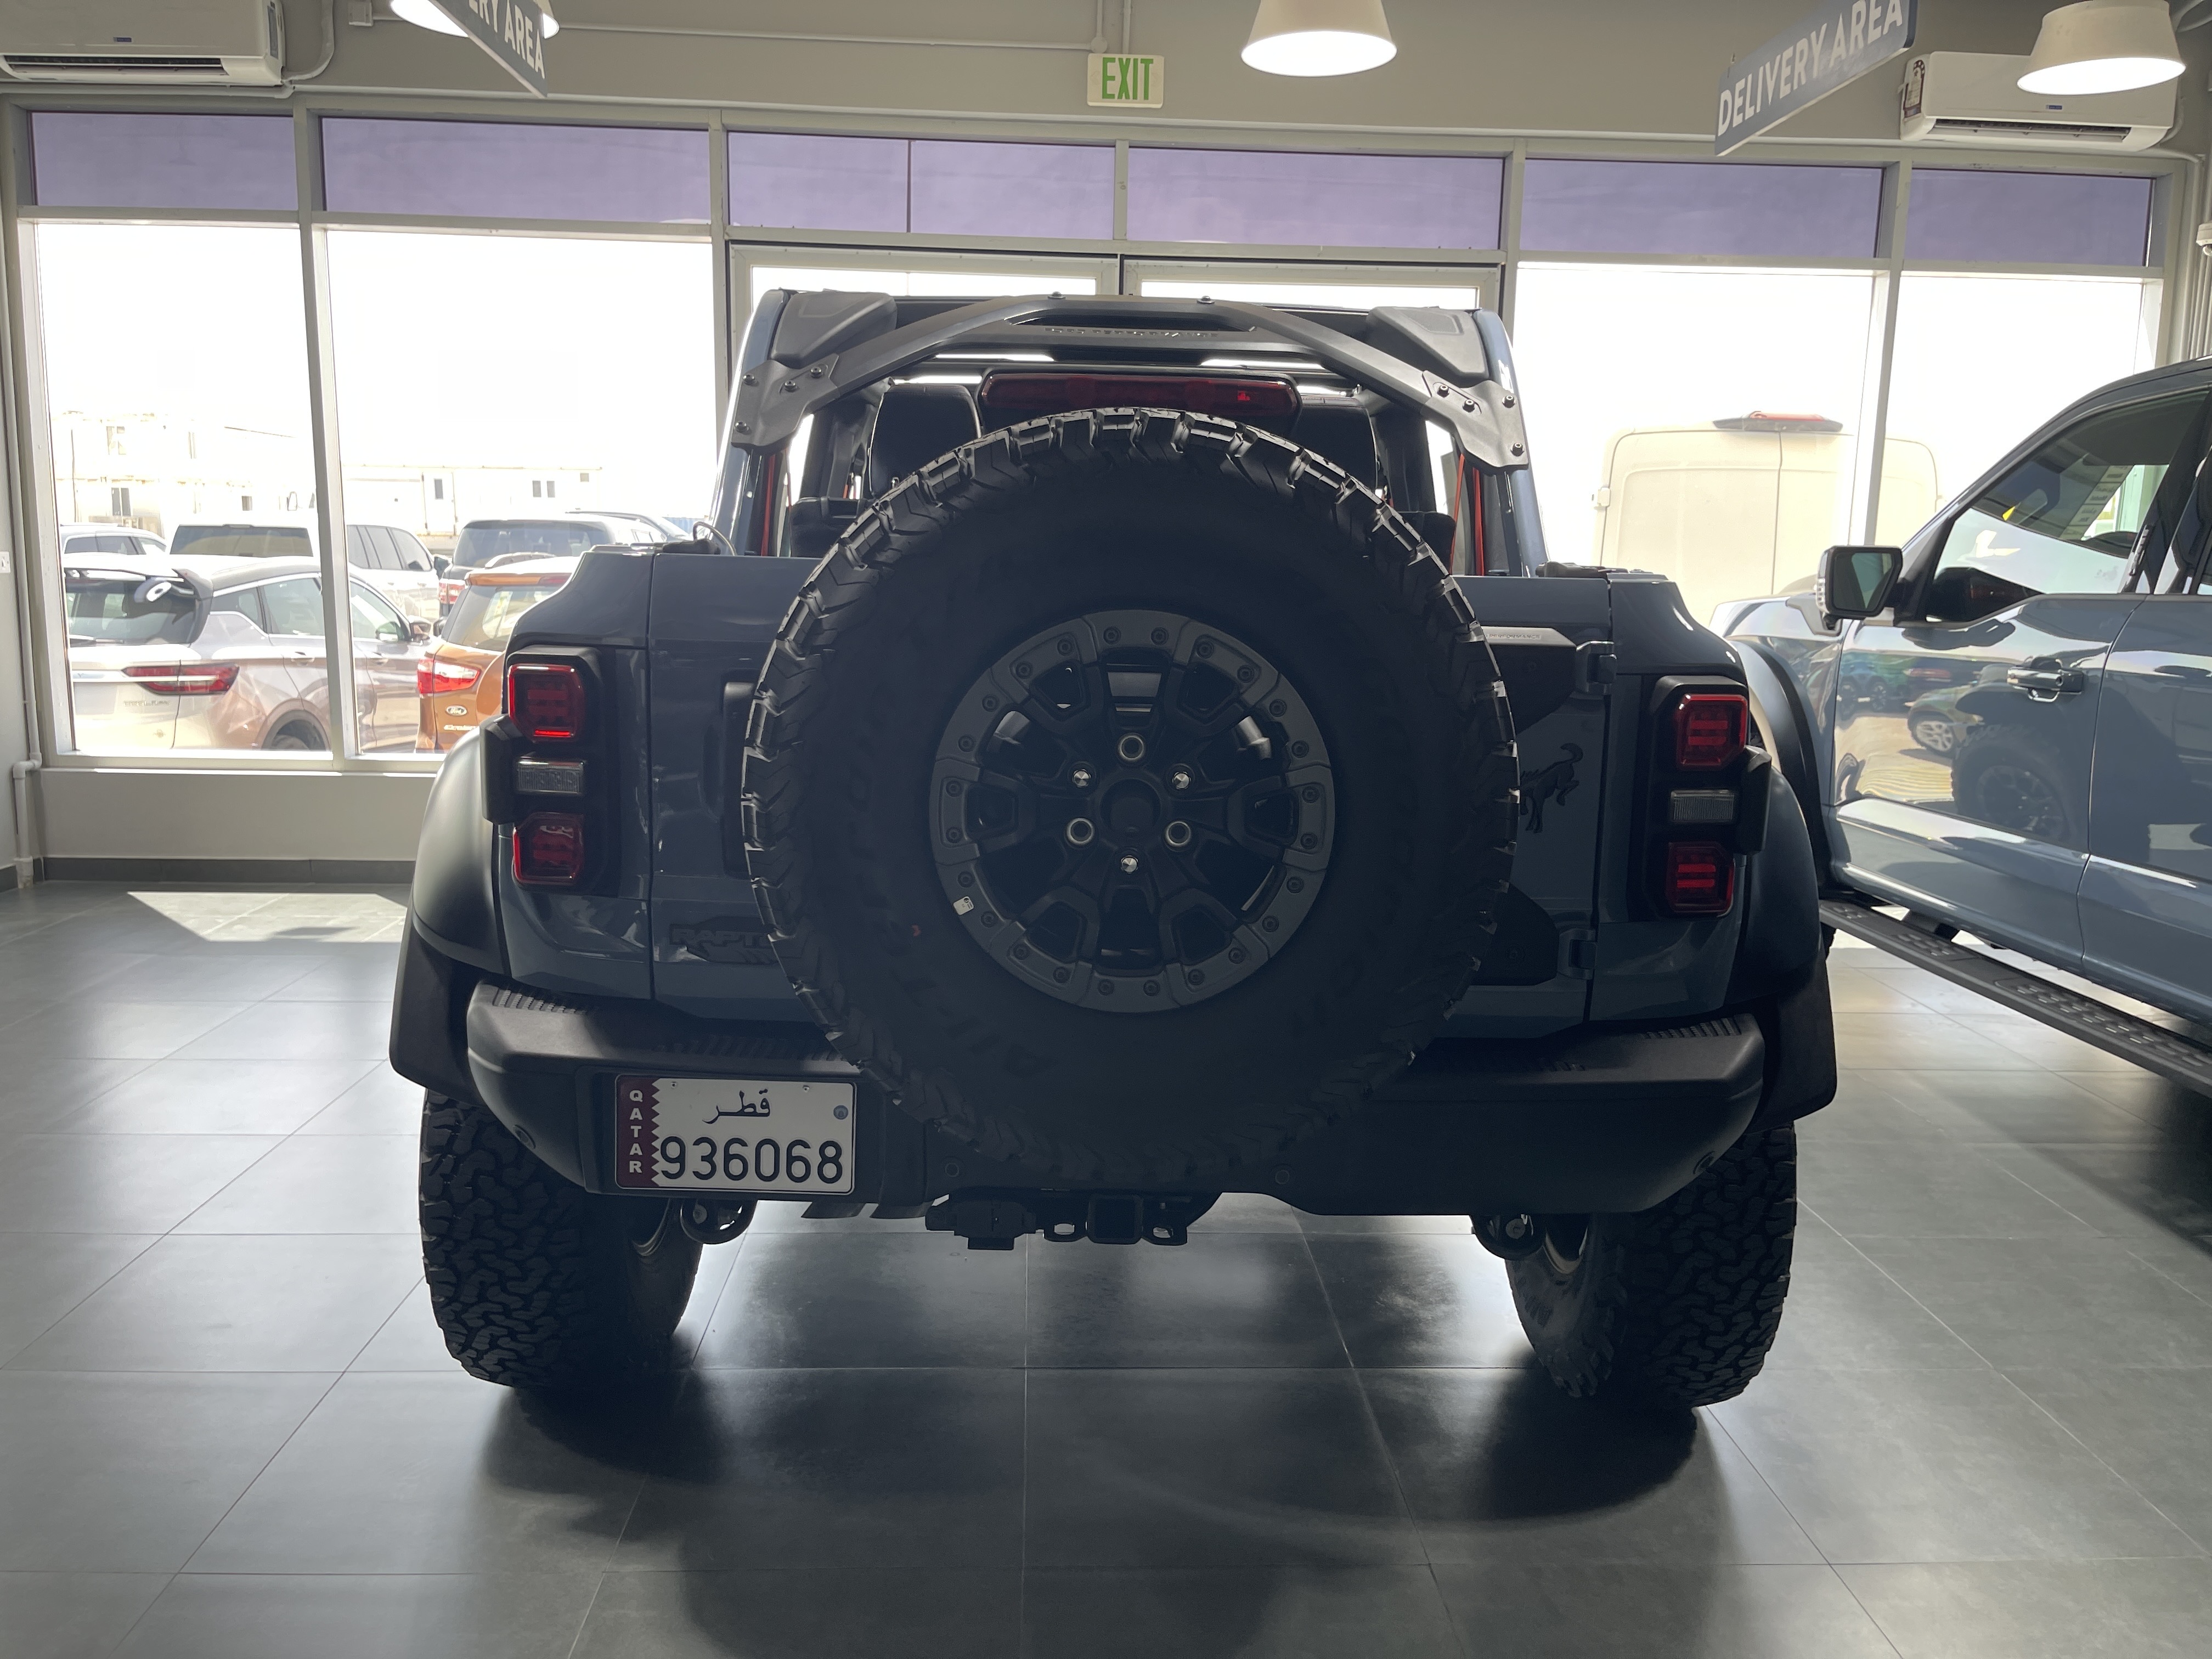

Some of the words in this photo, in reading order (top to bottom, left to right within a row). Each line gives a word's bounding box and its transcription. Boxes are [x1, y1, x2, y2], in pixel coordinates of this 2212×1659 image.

[505, 0, 545, 80] AREA
[1718, 23, 1827, 137] DELIVERY
[1829, 0, 1903, 68] AREA
[1102, 57, 1154, 100] EXIT
[629, 1090, 644, 1173] QATAR
[702, 1088, 770, 1124] قطر
[660, 1136, 843, 1184] 936068
